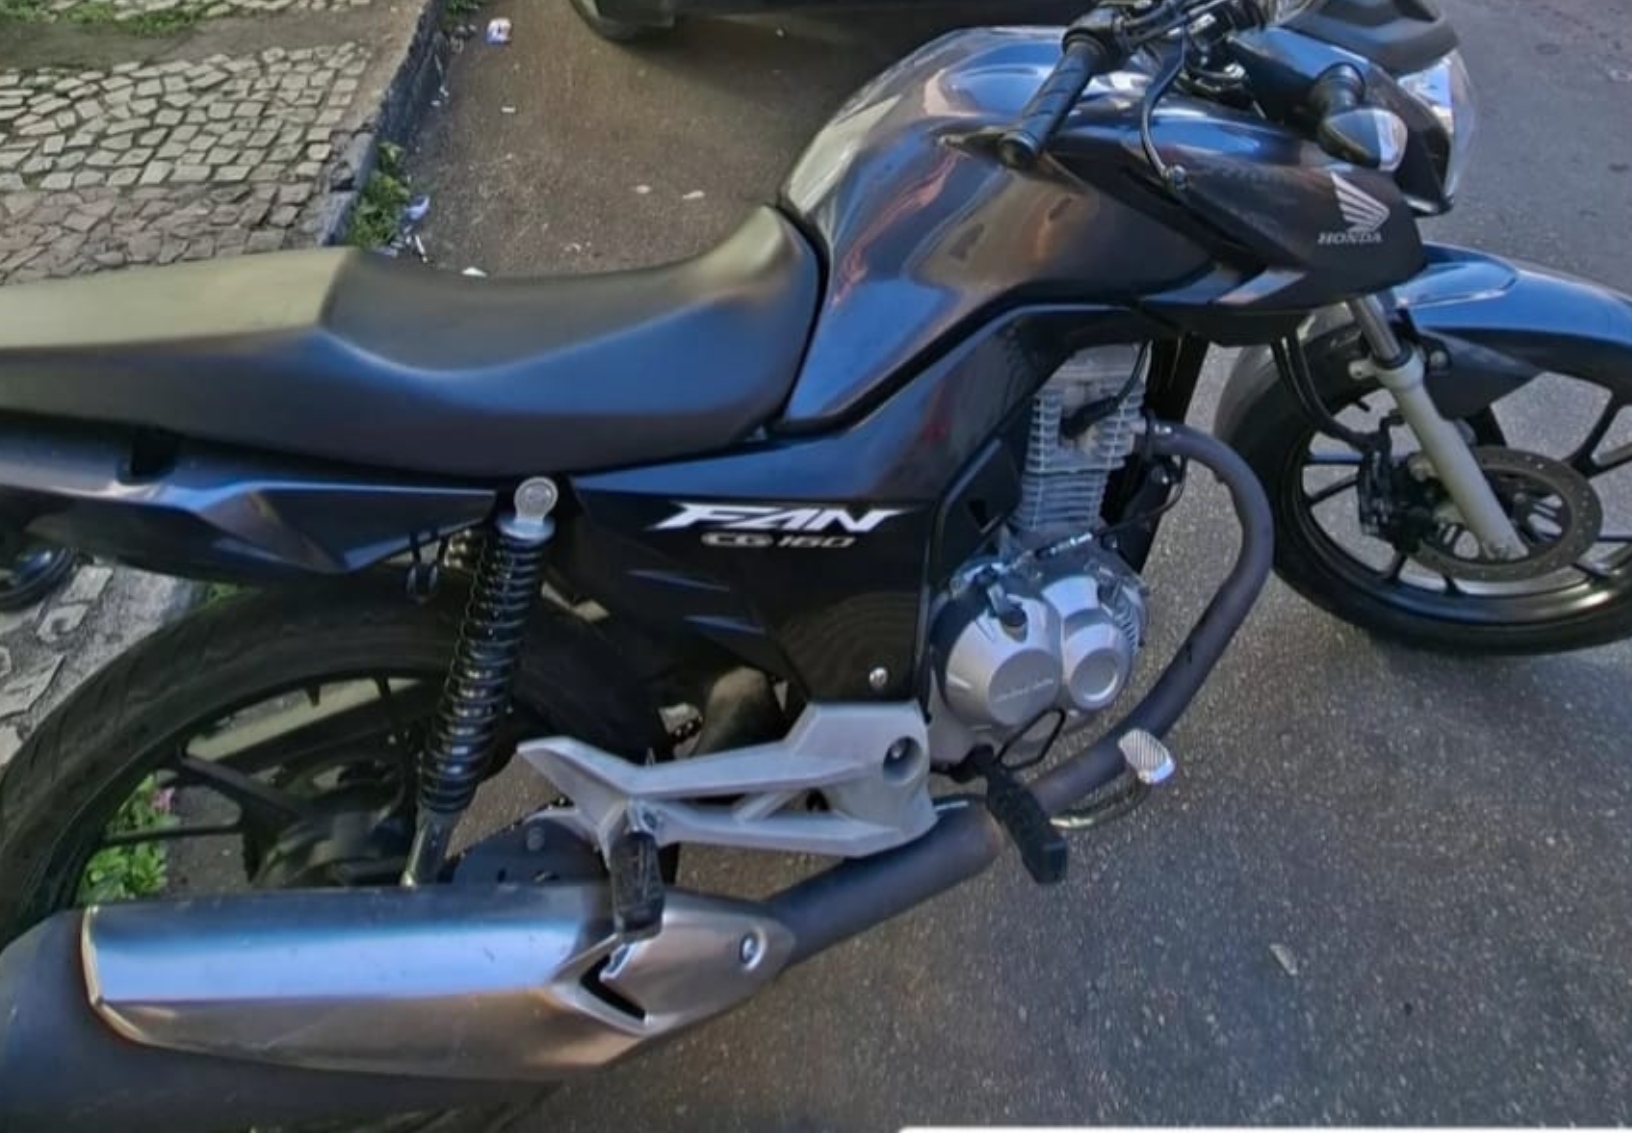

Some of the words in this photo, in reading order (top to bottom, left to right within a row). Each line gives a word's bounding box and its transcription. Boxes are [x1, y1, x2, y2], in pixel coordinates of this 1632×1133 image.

[1317, 231, 1382, 245] HONDA
[647, 502, 907, 532] FAN
[701, 532, 774, 547] CG
